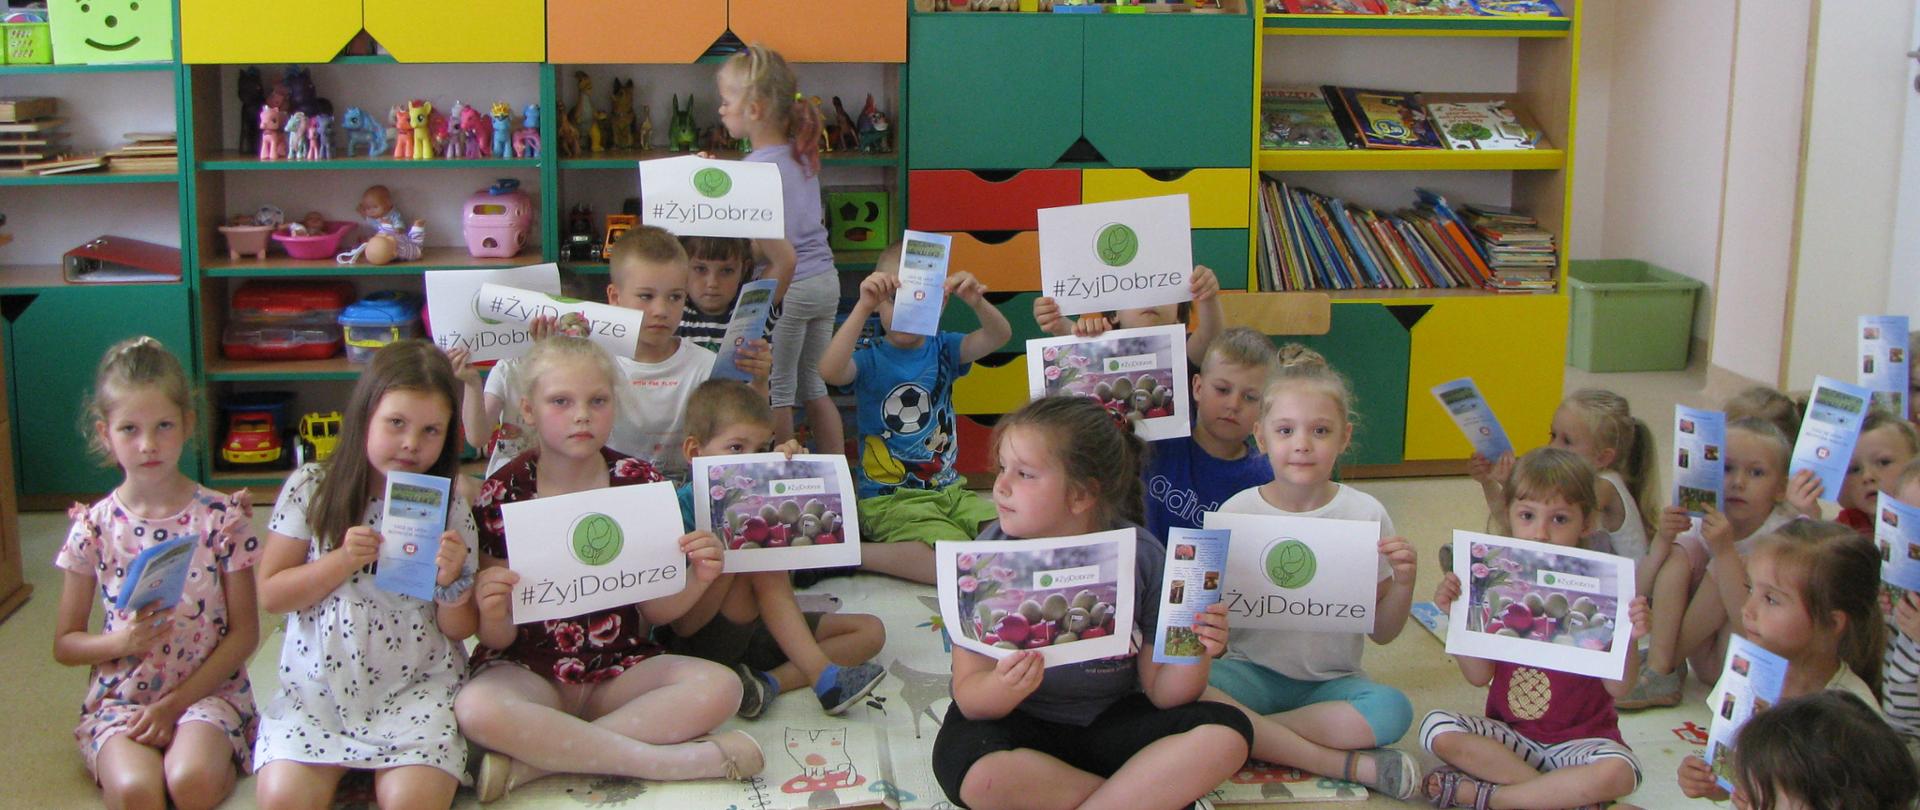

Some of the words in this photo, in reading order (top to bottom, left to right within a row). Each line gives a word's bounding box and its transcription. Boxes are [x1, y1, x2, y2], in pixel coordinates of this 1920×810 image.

[652, 200, 773, 224] #ŻyjDobrze
[1053, 272, 1182, 299] #ŻyjDobrze
[521, 564, 677, 606] #ŻyjDobrze
